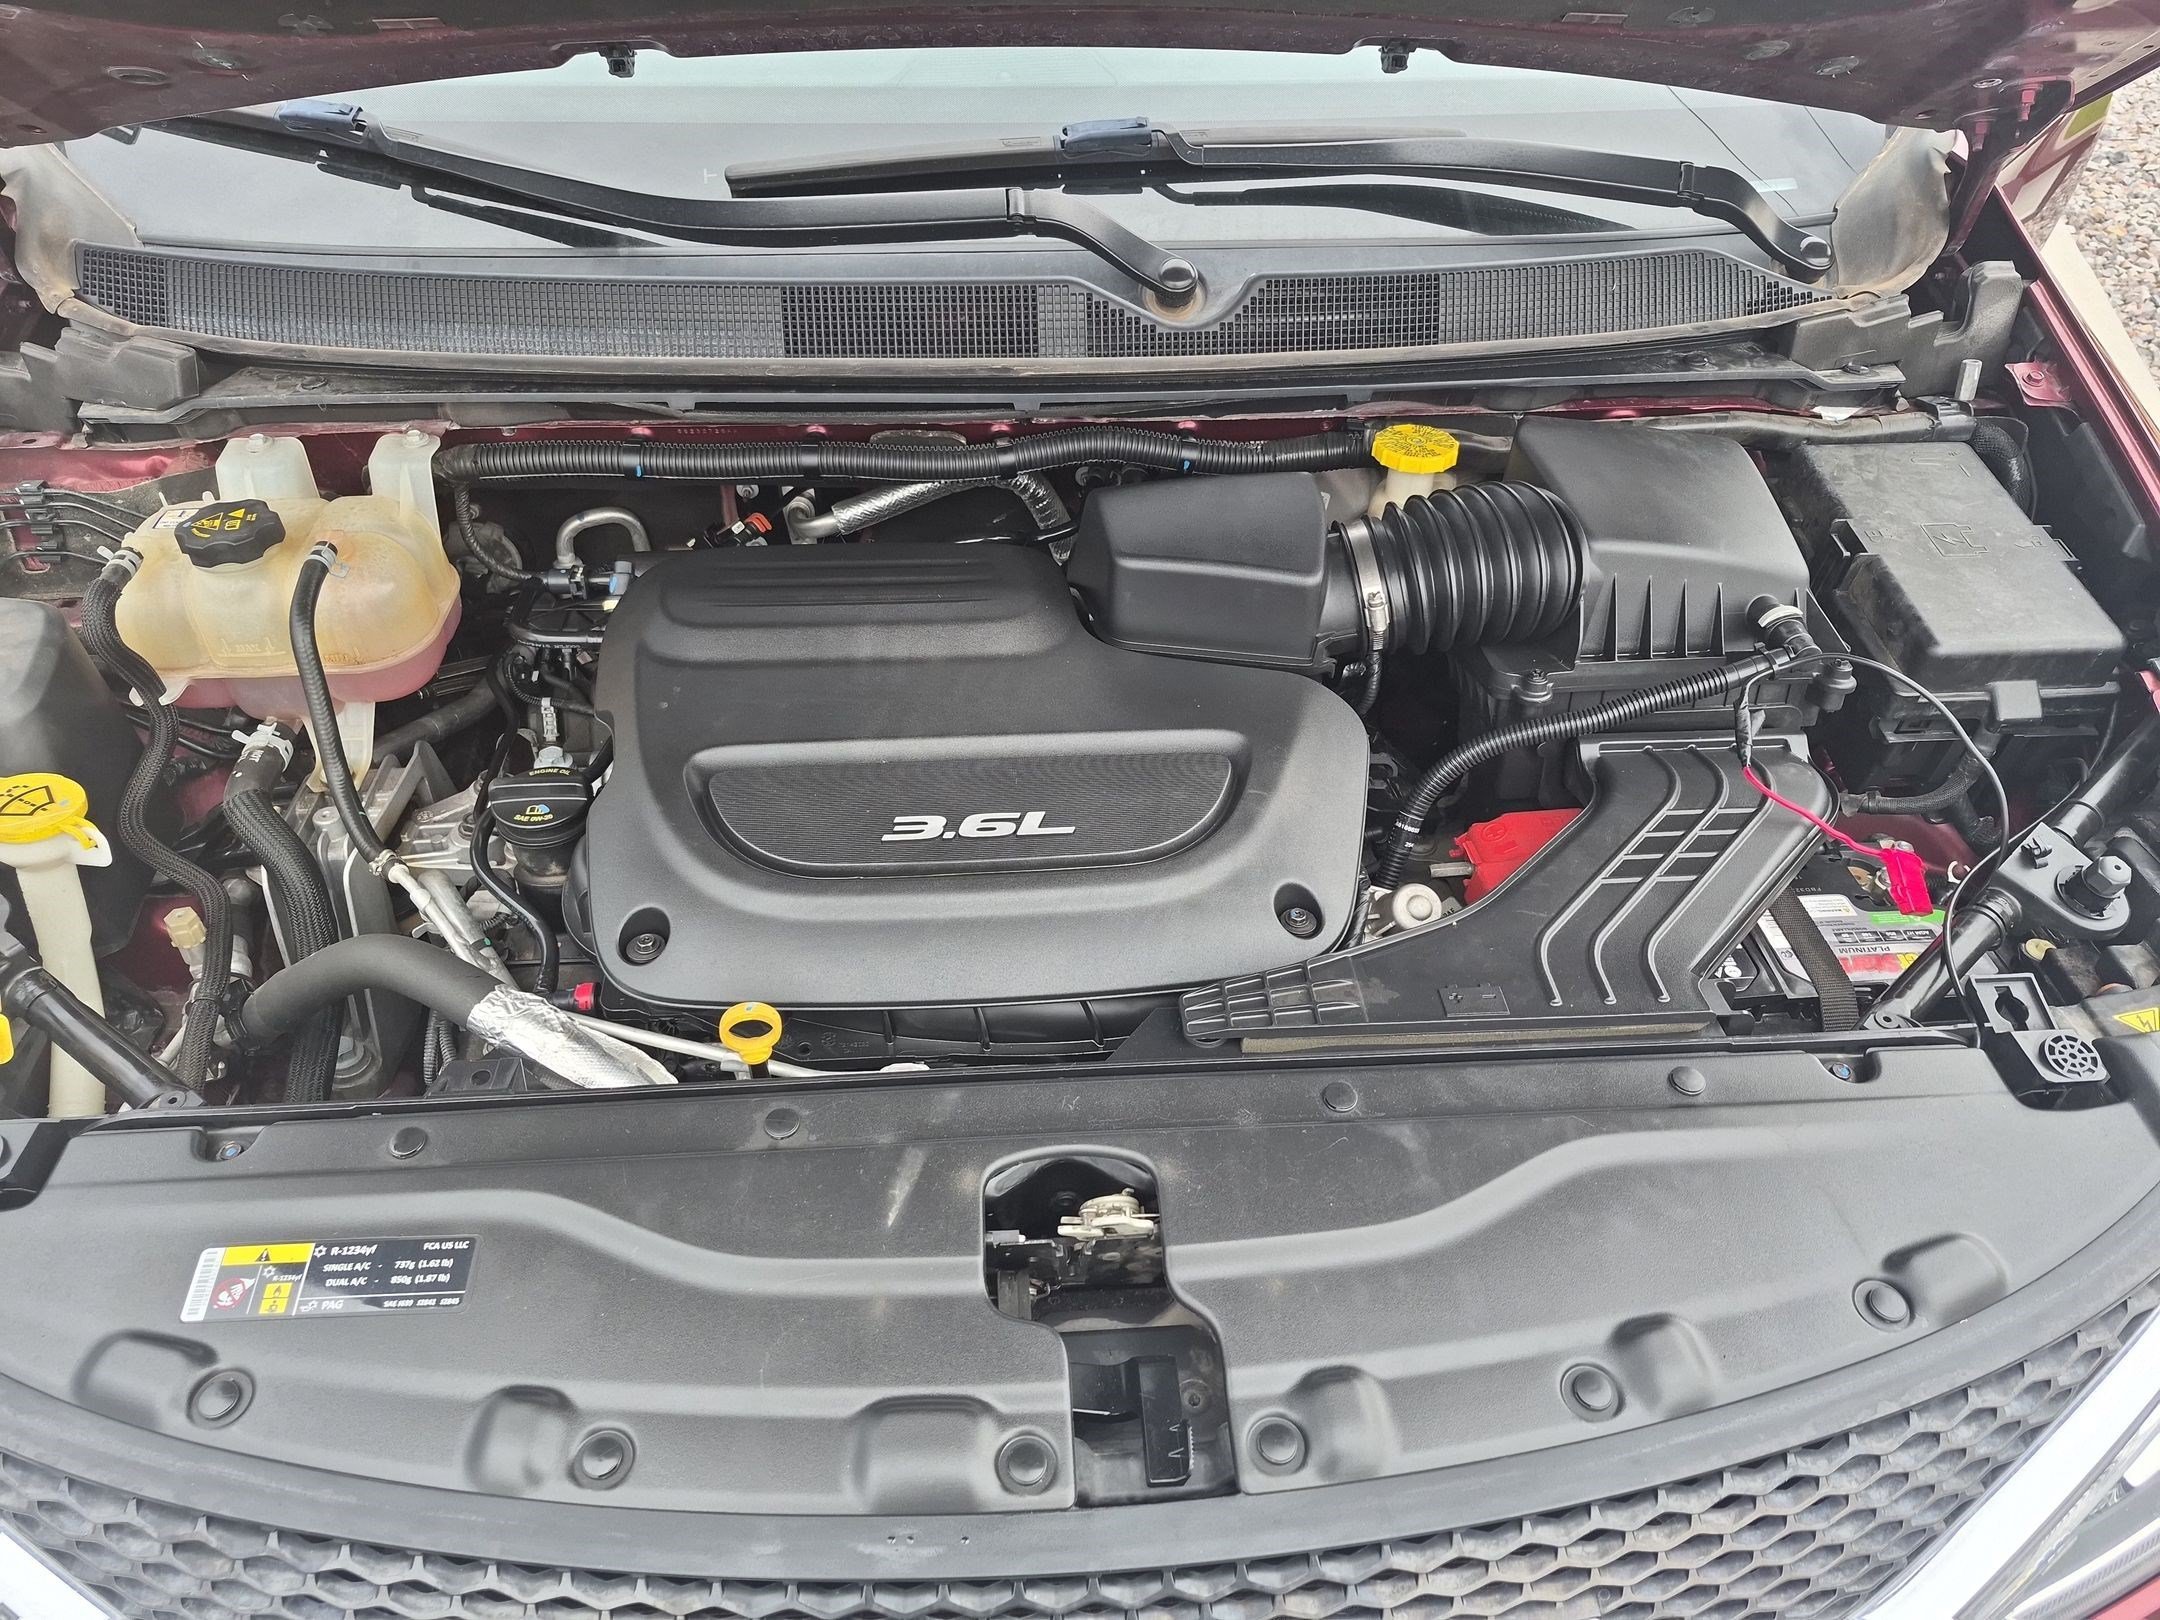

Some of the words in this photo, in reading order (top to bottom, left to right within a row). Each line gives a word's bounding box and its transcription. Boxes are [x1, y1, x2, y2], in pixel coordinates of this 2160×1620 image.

[529, 768, 558, 776] ENGINE
[514, 814, 529, 822] SAE
[881, 811, 1076, 842] 3.6L
[1838, 946, 1890, 954] PLATINUM
[423, 1242, 440, 1251] FCA
[440, 1242, 454, 1250] US
[454, 1241, 470, 1249] LLC
[322, 1263, 354, 1272] SINGLE
[354, 1262, 372, 1271] A/C
[394, 1260, 416, 1270] 737g
[418, 1259, 441, 1269] (1.62
[325, 1278, 350, 1287] DUAL
[350, 1277, 368, 1287] A/C
[321, 1300, 345, 1310] PAG
